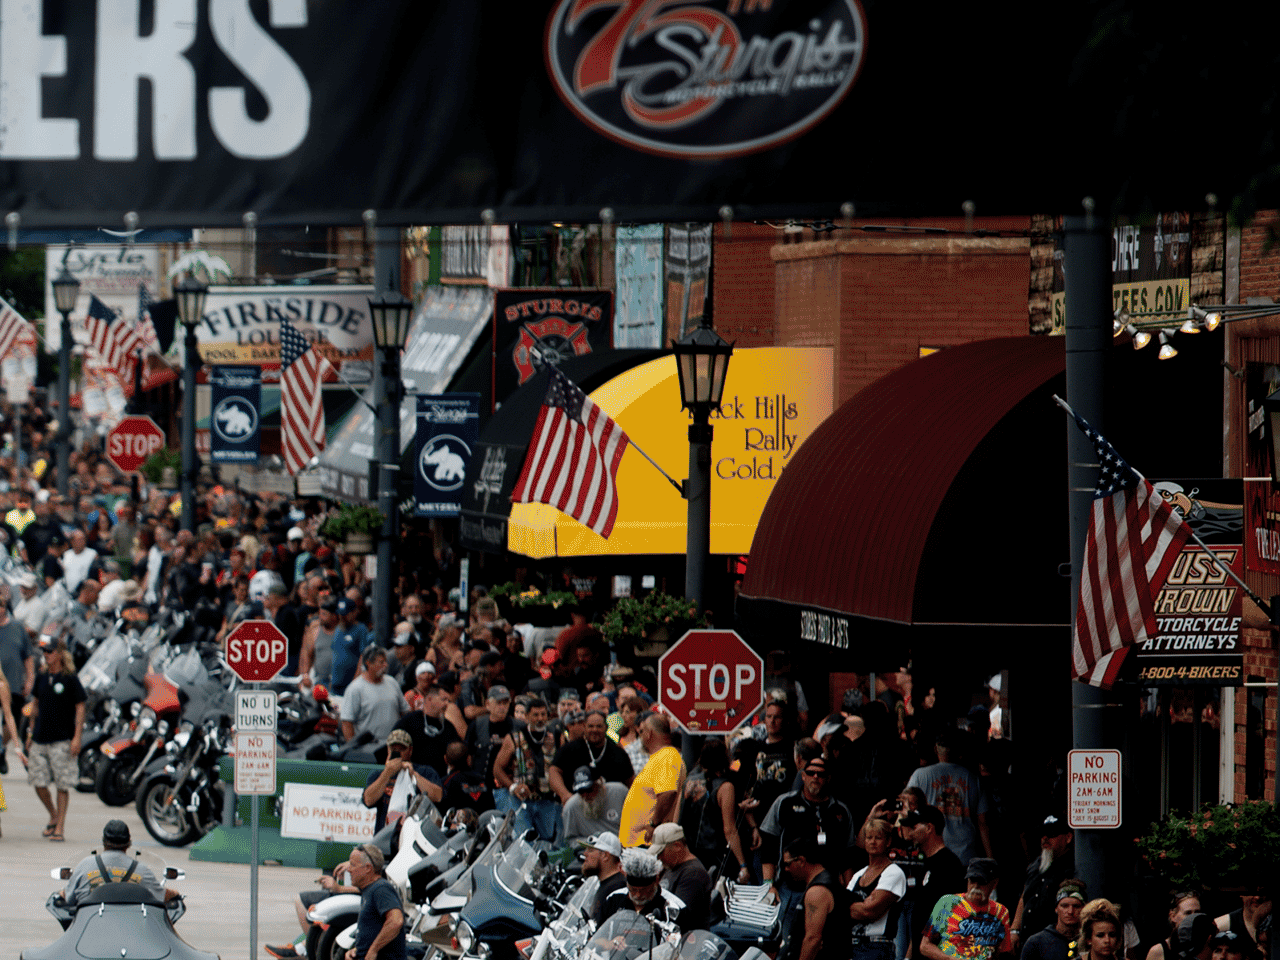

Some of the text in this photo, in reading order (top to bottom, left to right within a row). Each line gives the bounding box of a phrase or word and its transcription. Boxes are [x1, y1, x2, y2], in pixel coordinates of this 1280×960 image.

[616, 18, 856, 102] Sturgis
[202, 295, 367, 337] FIRESIDE
[503, 297, 603, 323] STURGIS
[236, 328, 329, 346] LOUGE
[754, 394, 799, 421] Hills
[109, 433, 157, 457] STOP
[744, 427, 798, 460] Rally
[1167, 552, 1235, 585] USS
[228, 638, 285, 663] STOP
[1141, 634, 1239, 651] ATTORNEYS
[666, 662, 756, 701] STOP
[241, 697, 271, 709] NO U
[239, 714, 274, 727] TURNS
[247, 737, 264, 748] NO
[238, 750, 273, 759] PARKING
[1084, 756, 1104, 769] NO
[1072, 772, 1118, 784] PARKING
[1076, 787, 1113, 797] 2AM-6AM
[292, 805, 310, 818] NO
[312, 806, 362, 823] PARKING
[321, 821, 345, 834] THIS
